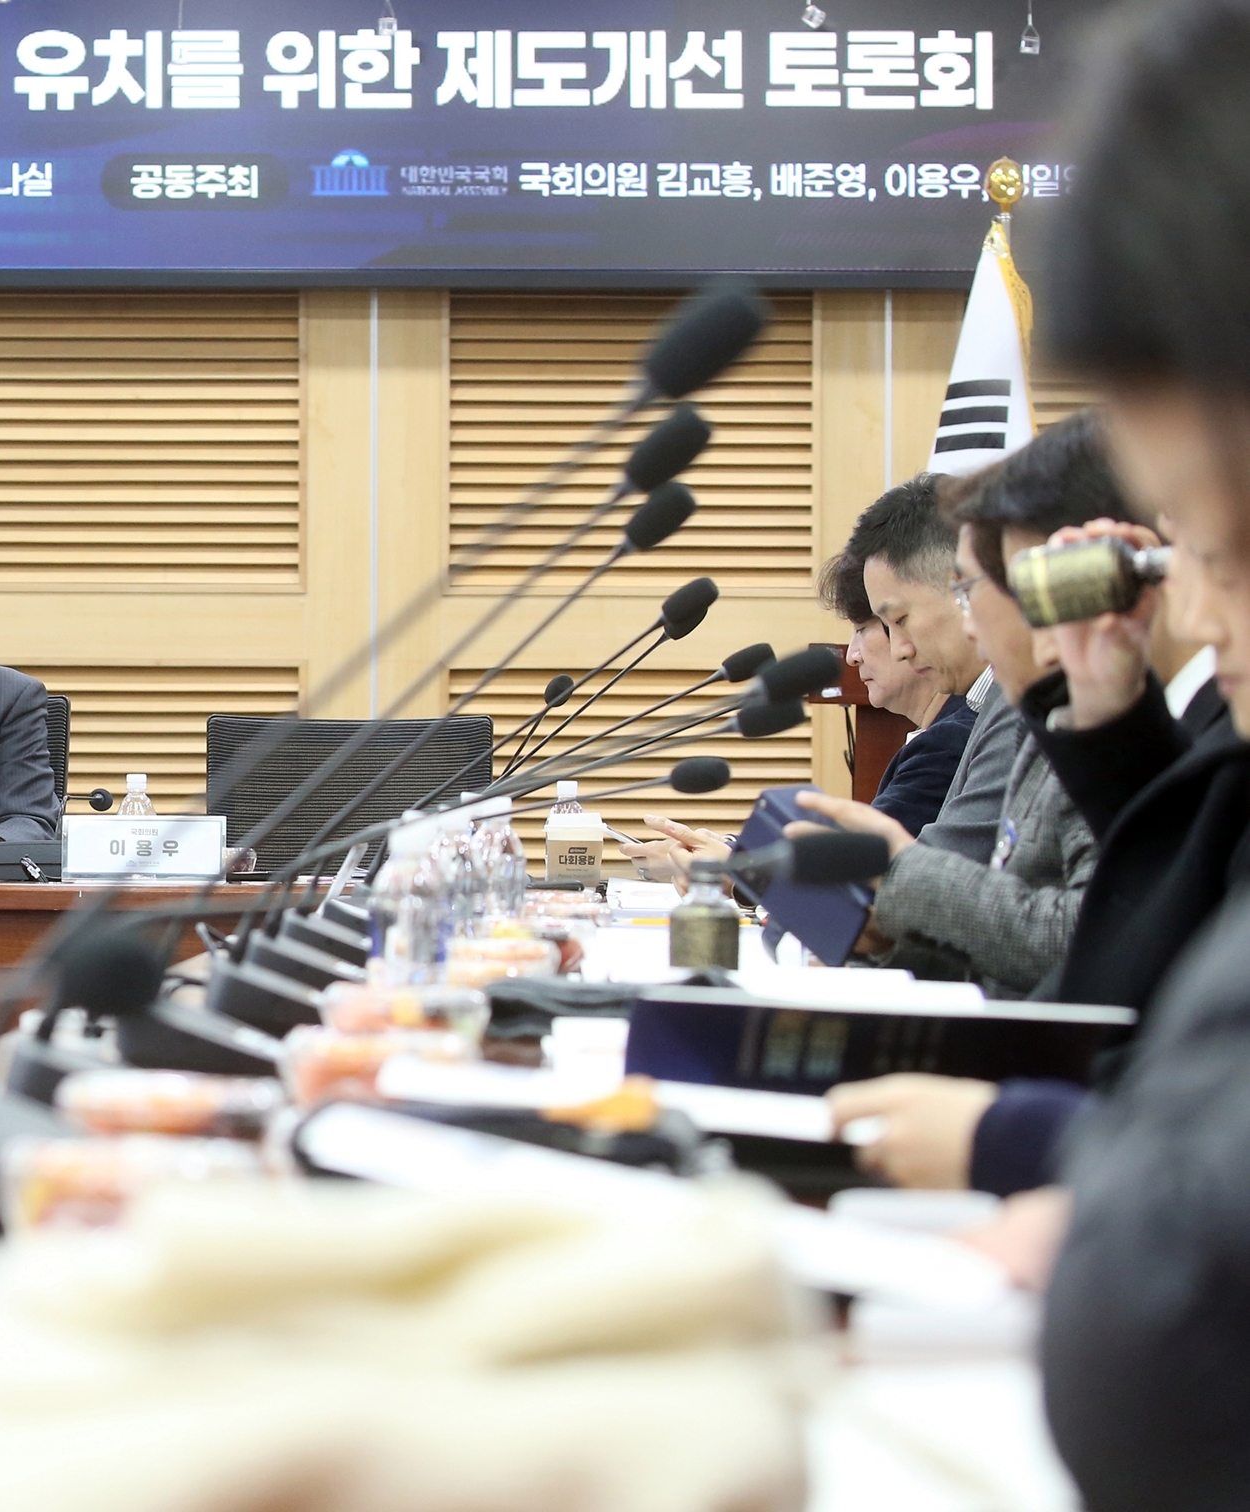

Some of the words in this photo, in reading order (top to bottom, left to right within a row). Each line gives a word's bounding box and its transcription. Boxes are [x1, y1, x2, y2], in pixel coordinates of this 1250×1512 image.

[14, 30, 245, 111] 유치를
[263, 30, 420, 109] 위한
[436, 30, 744, 109] 제도개선
[765, 30, 993, 110] 토론회
[130, 164, 260, 199] 공동주최
[519, 161, 648, 198] 국회의원
[656, 161, 763, 201] 김교흥,
[771, 162, 877, 202] 배준영,
[884, 162, 990, 202] 이용우,
